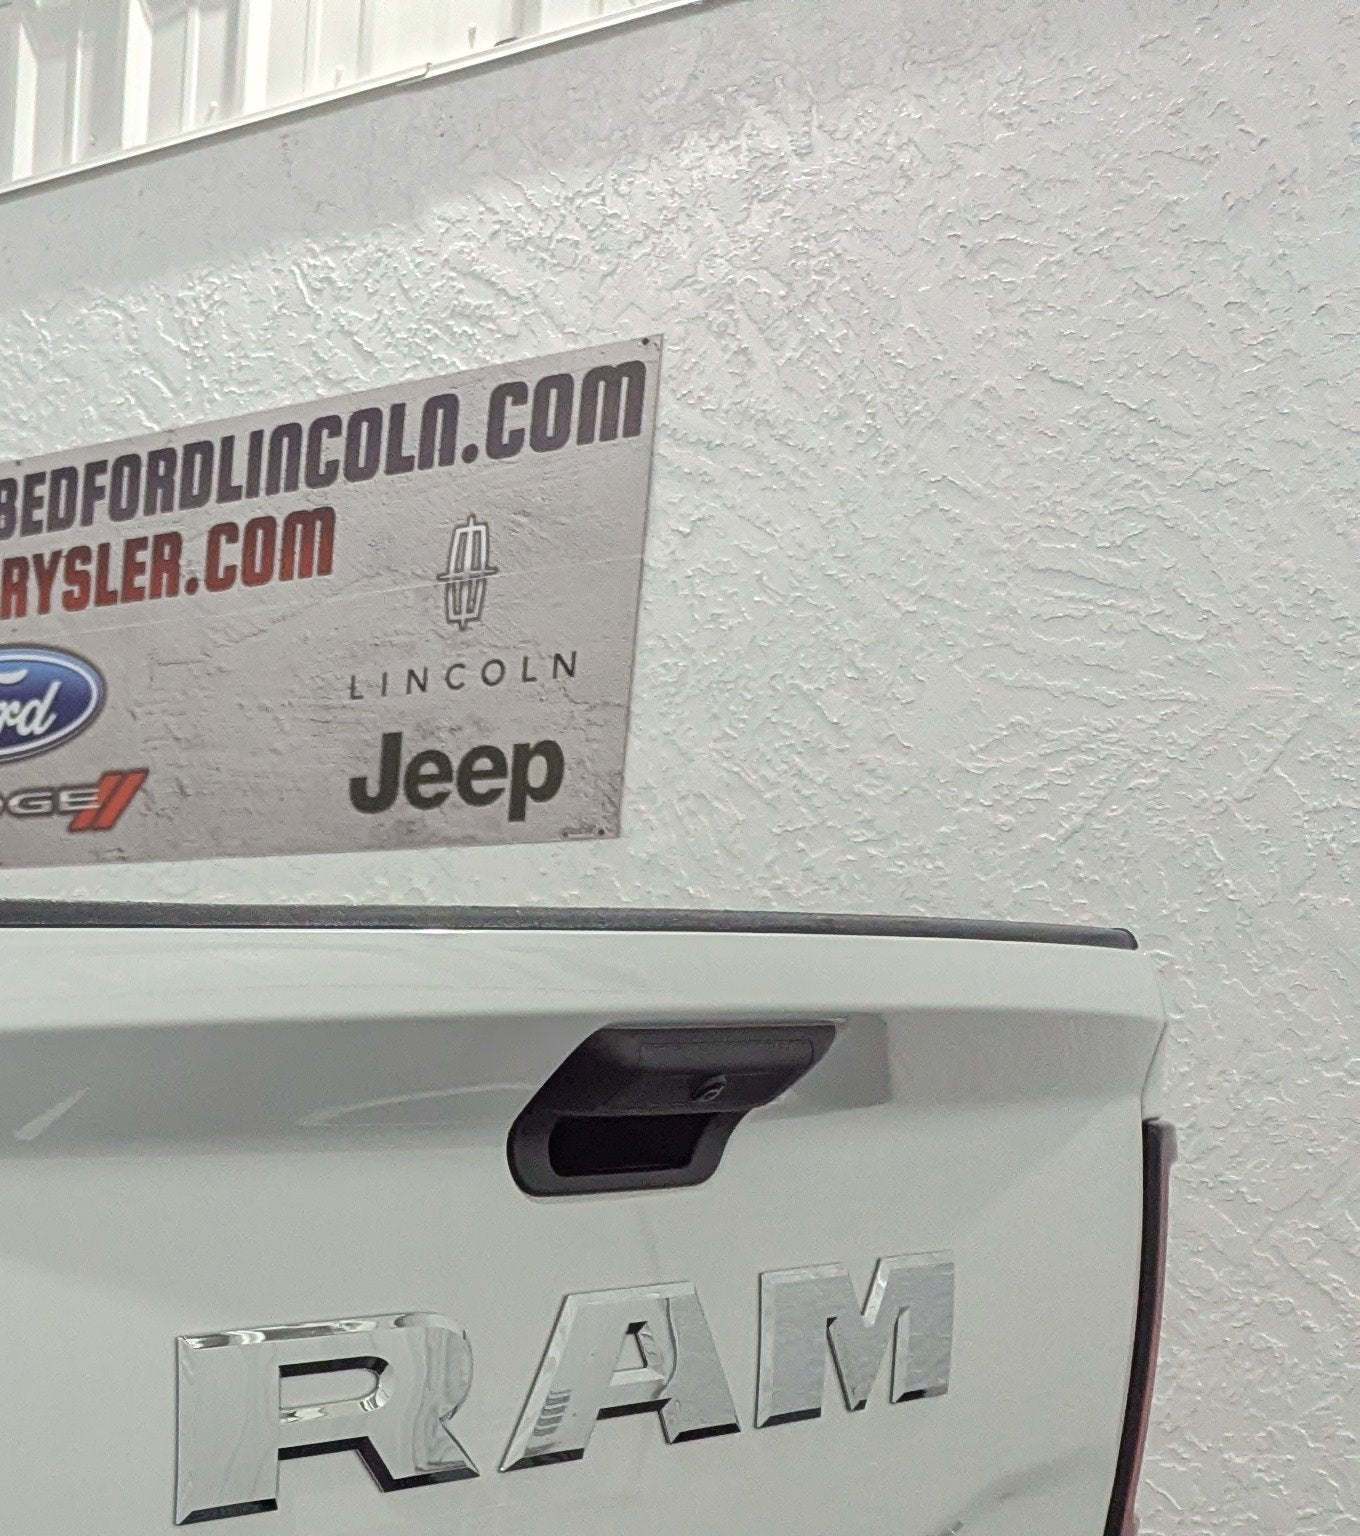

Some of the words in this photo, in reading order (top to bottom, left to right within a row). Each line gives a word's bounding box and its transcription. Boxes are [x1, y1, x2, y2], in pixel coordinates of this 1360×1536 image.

[349, 651, 577, 701] LINCOLN
[350, 731, 565, 822] Jeep
[176, 1250, 954, 1526] RAM
